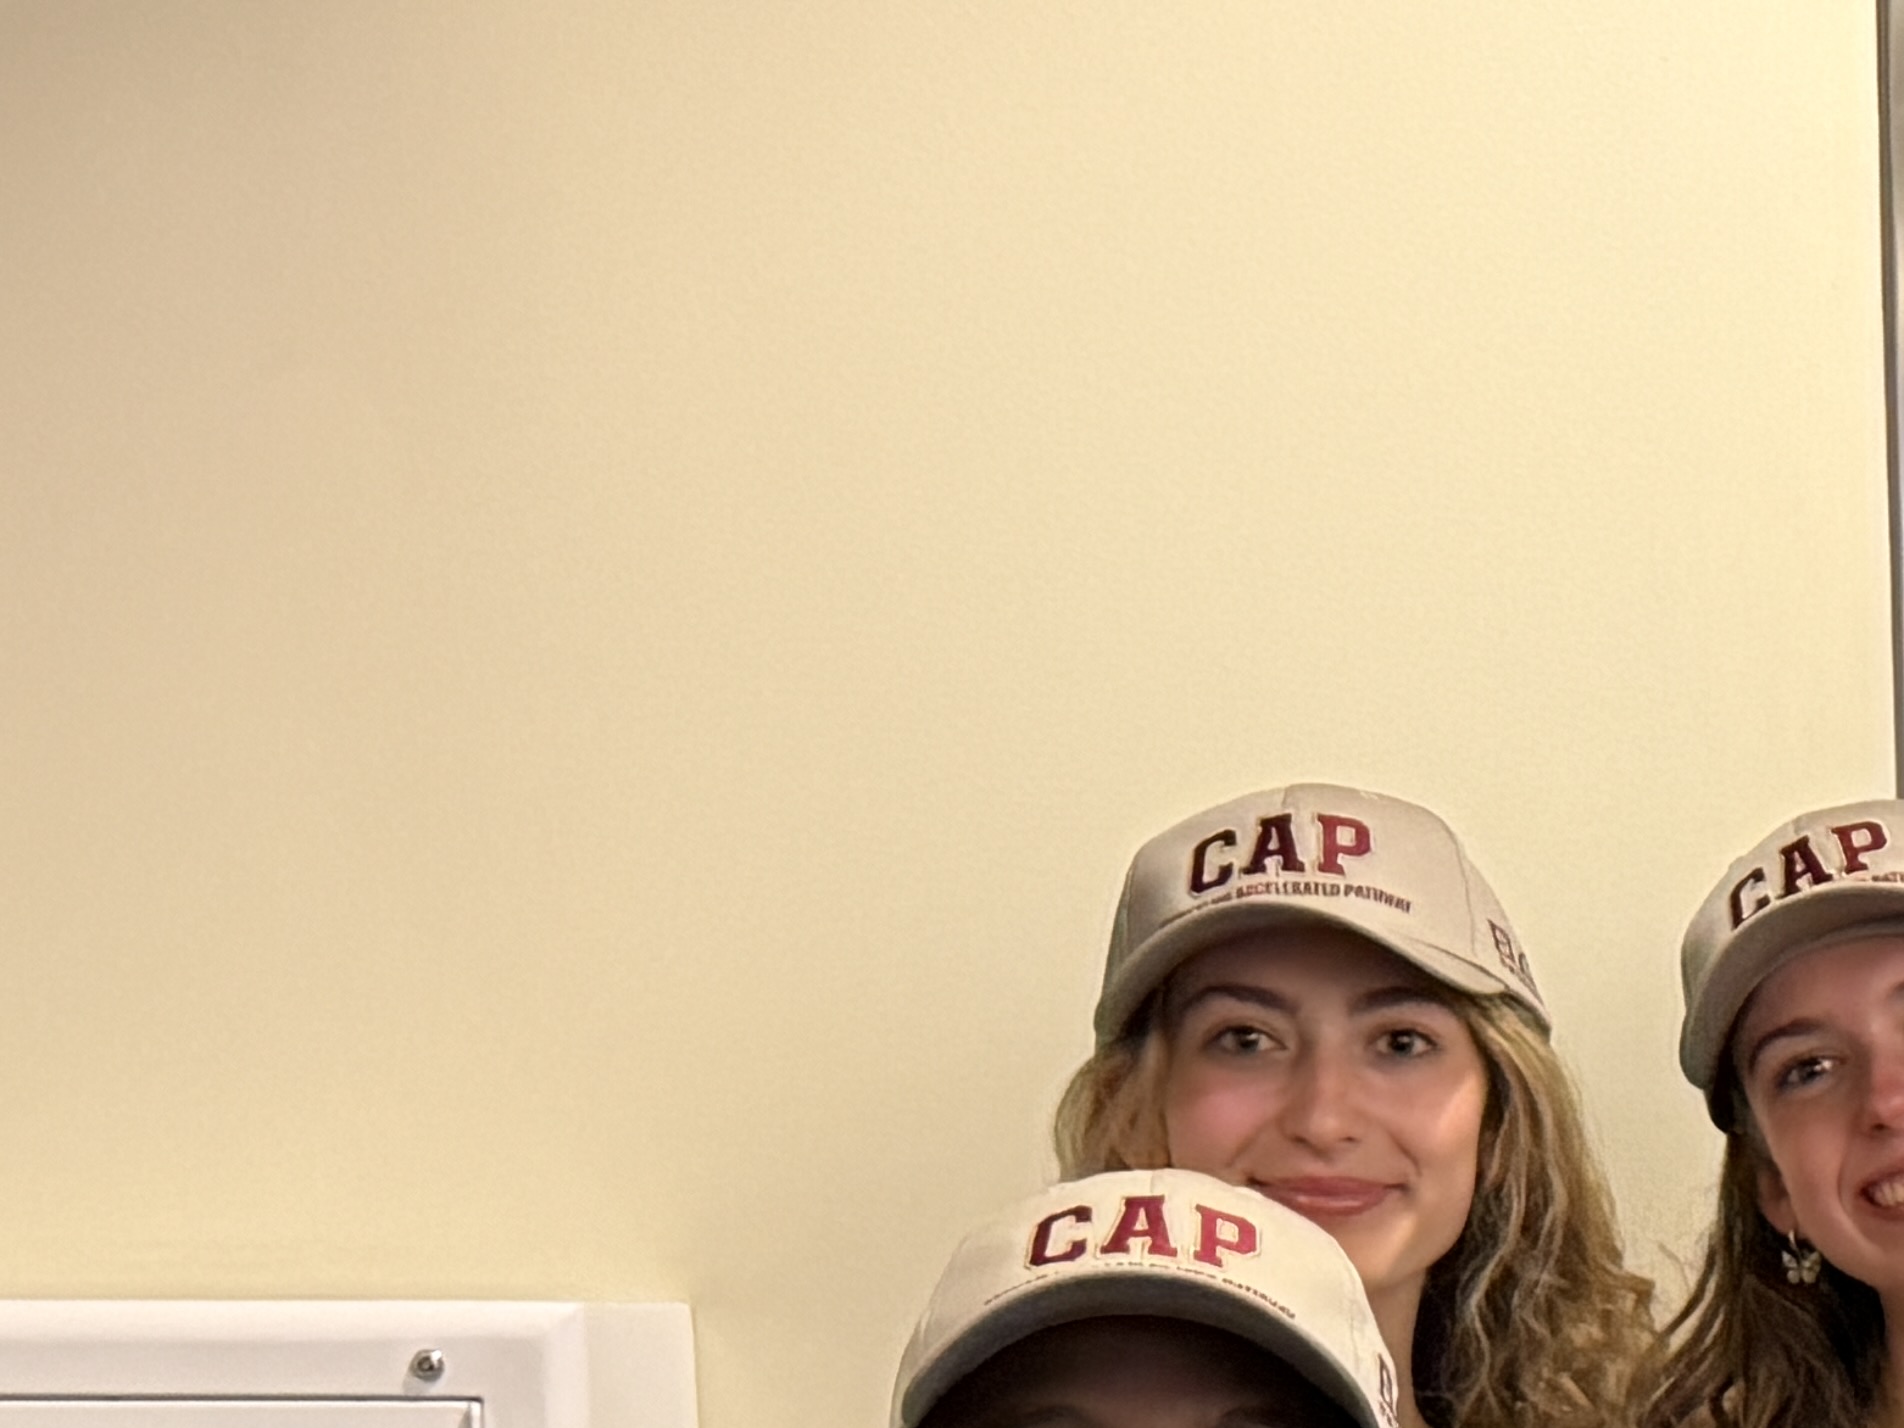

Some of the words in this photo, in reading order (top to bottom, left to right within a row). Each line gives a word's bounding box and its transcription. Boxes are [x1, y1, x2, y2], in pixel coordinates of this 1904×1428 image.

[1188, 812, 1373, 896] CAP
[1729, 820, 1889, 930] CAP
[1028, 1193, 1260, 1268] CAP
